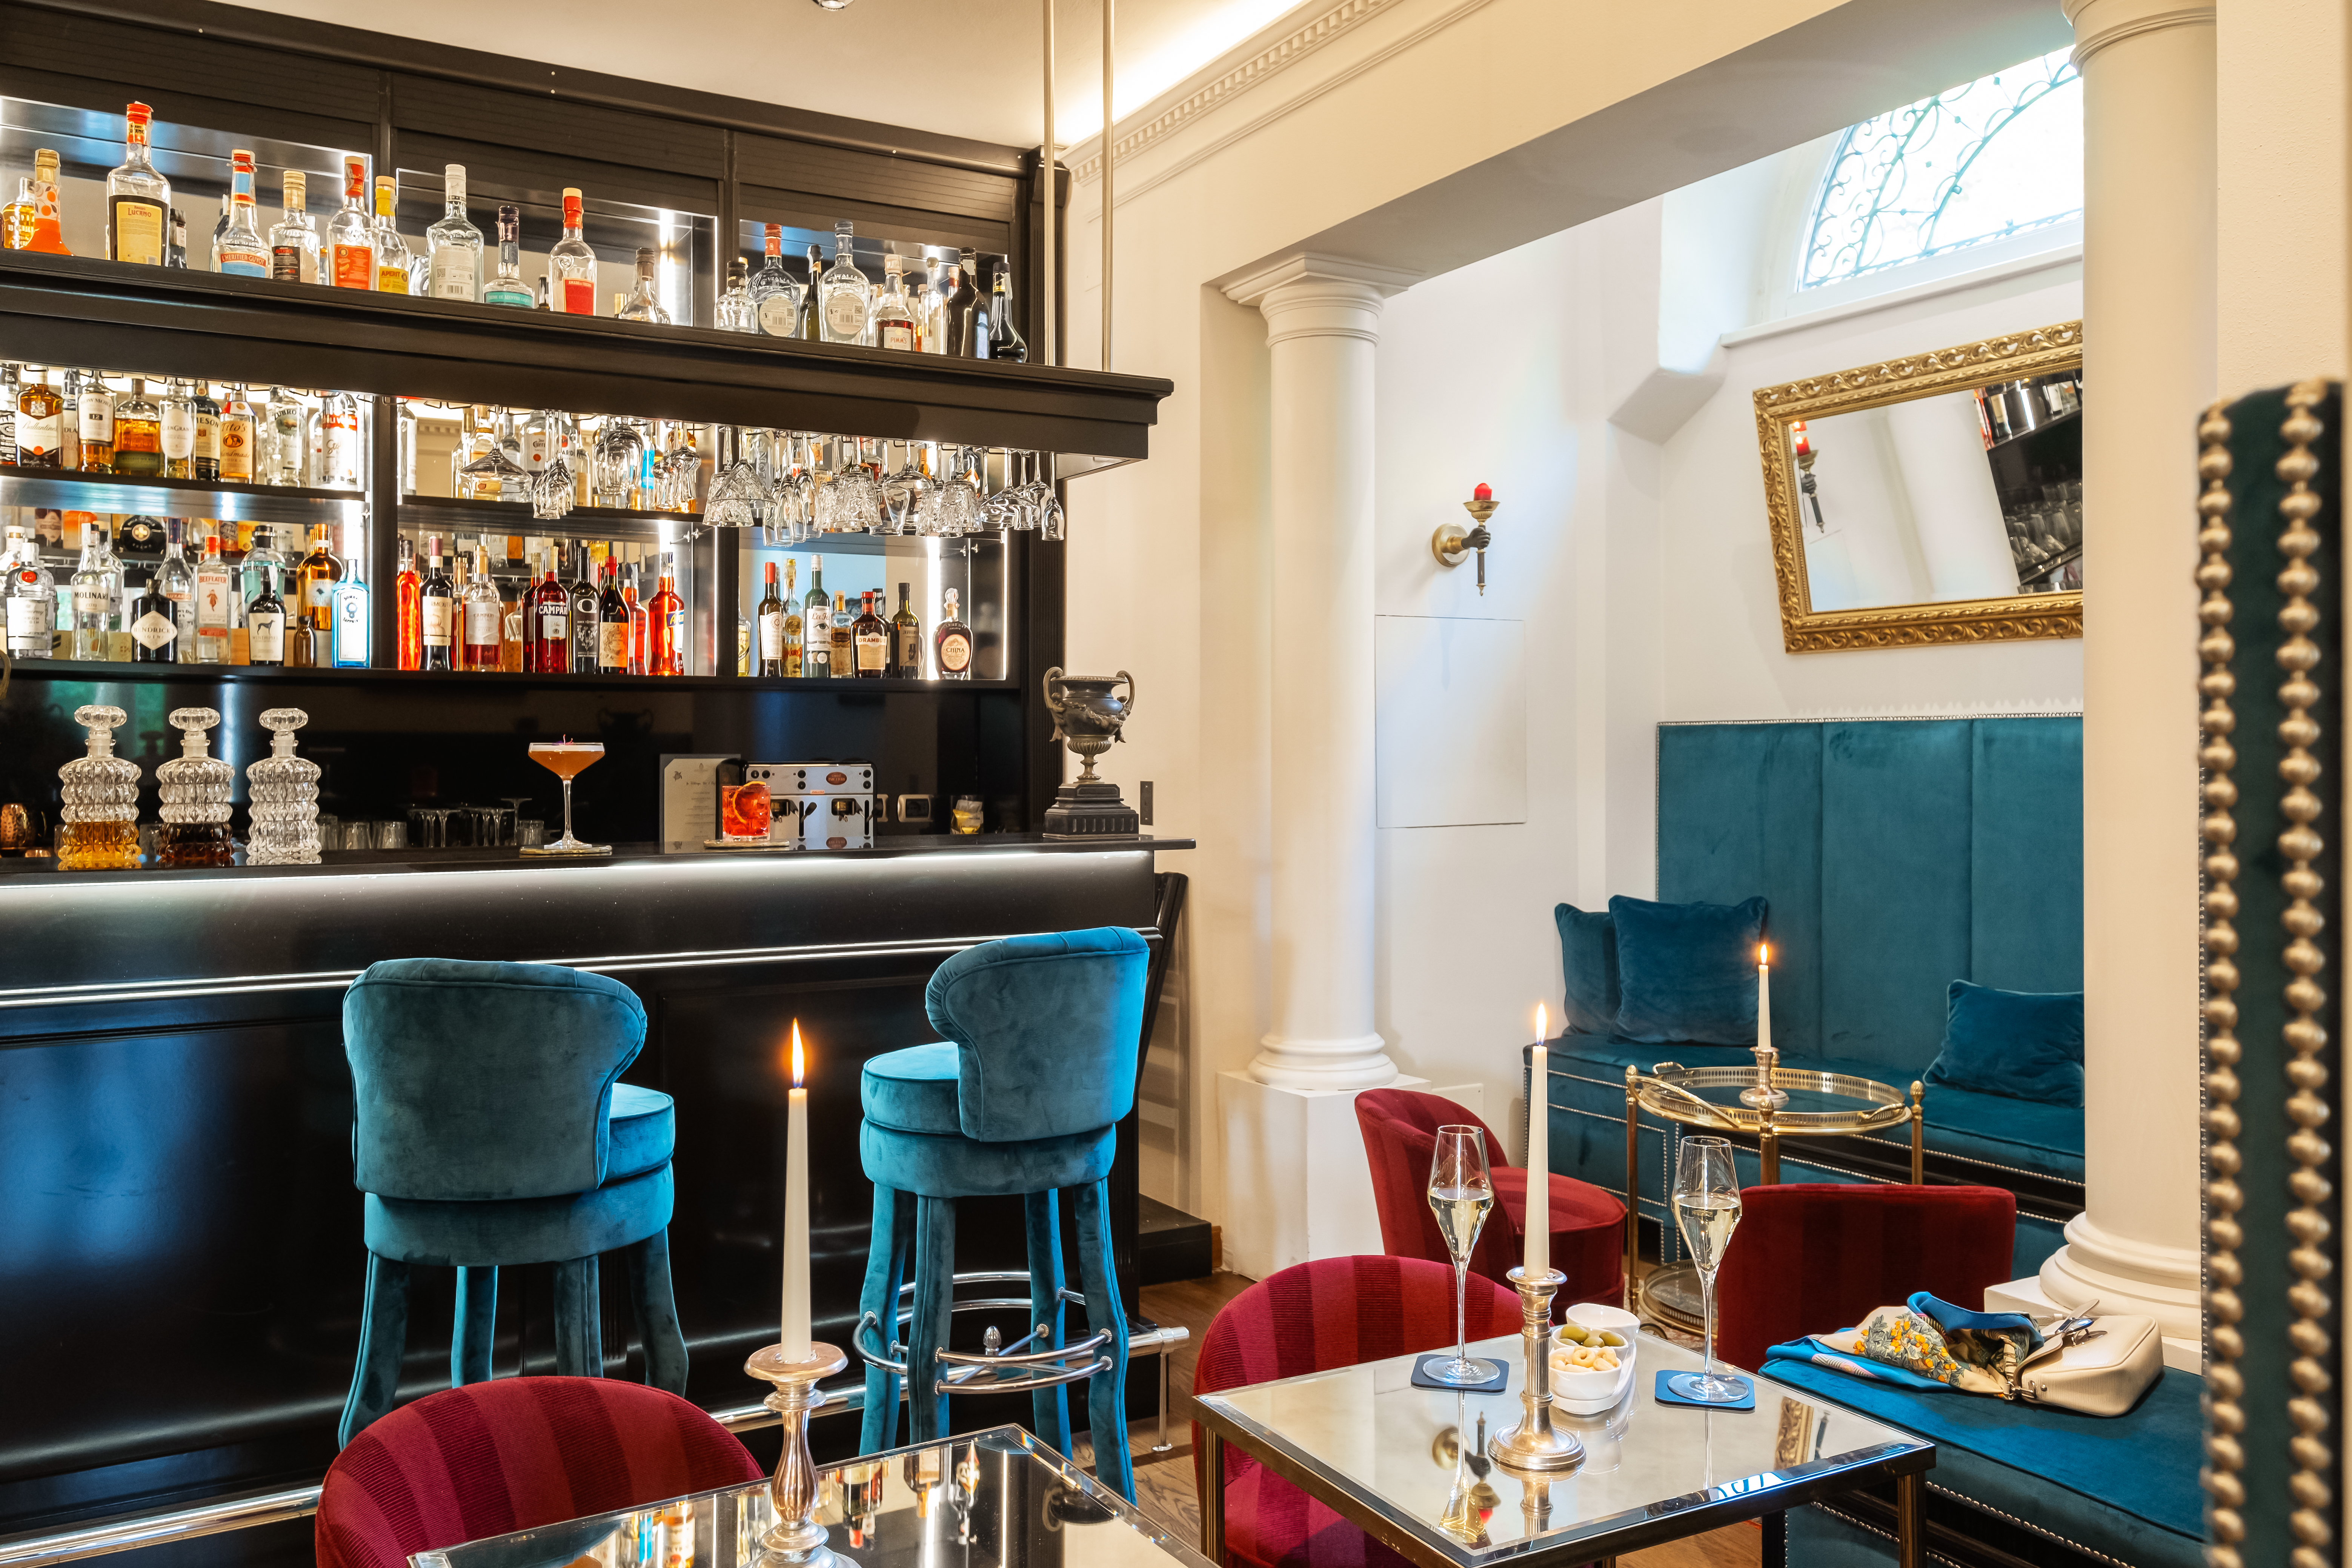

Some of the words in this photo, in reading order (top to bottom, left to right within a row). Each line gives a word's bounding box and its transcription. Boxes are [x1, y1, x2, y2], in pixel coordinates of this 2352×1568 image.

[197, 417, 219, 428] ESON
[221, 422, 247, 432] Tito's
[74, 592, 108, 600] MOLINARI
[577, 598, 597, 614] Q
